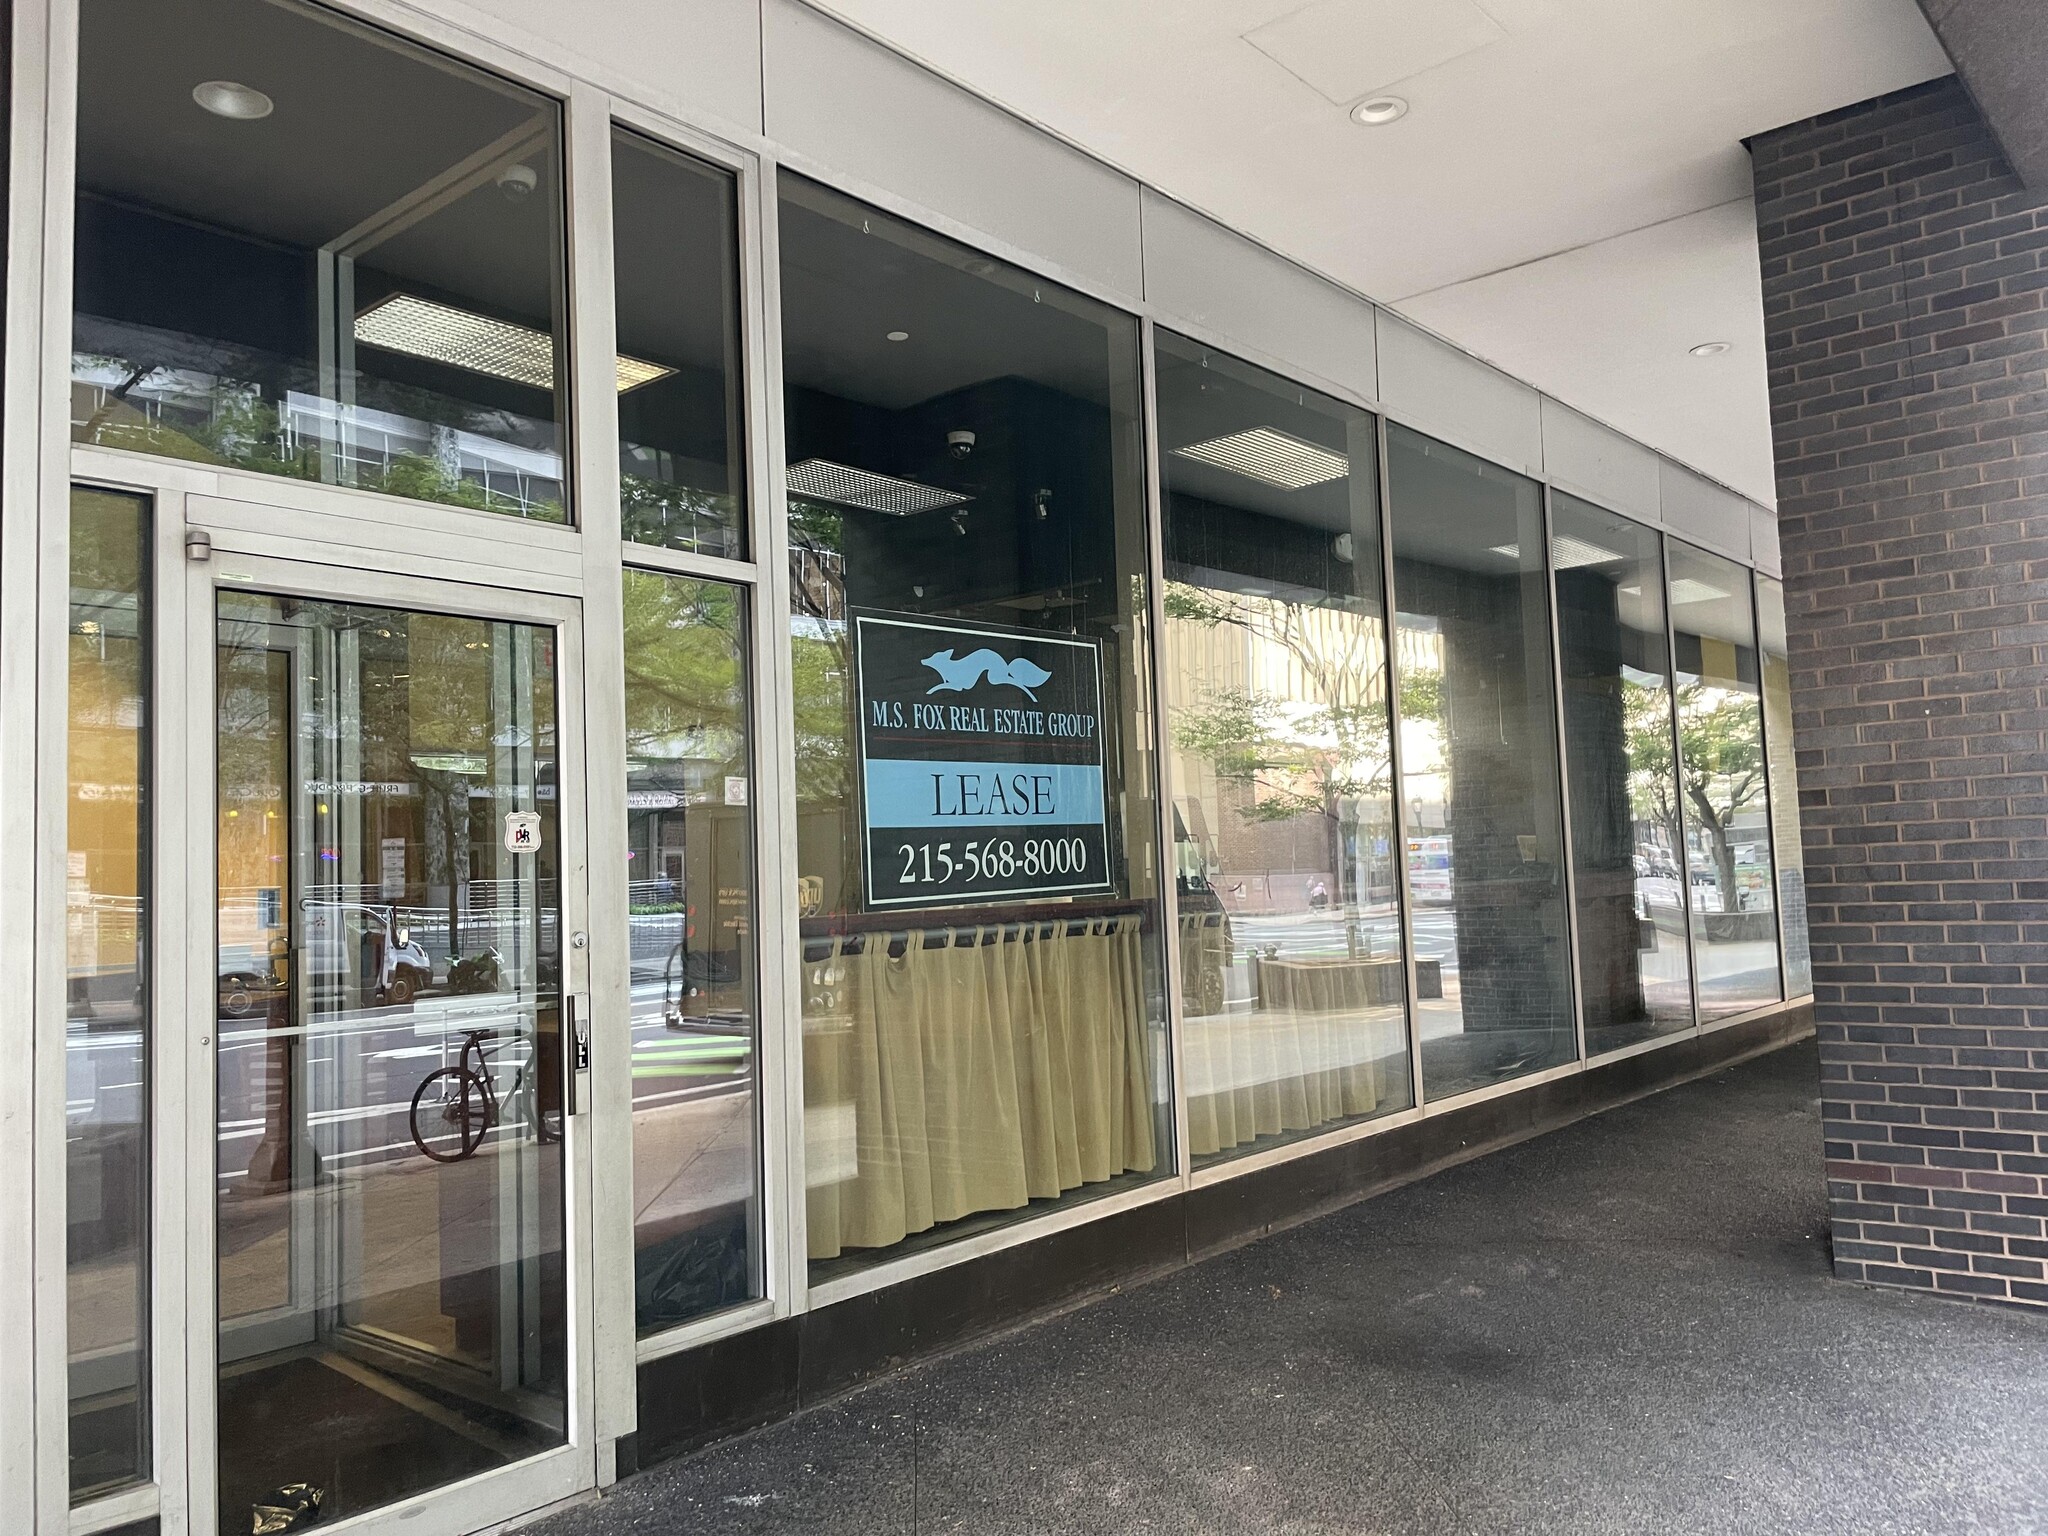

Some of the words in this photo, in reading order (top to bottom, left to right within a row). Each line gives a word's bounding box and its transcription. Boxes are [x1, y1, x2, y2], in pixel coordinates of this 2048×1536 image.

[872, 700, 908, 729] M.S.
[913, 703, 946, 732] FOX
[949, 706, 990, 733] REAL
[993, 709, 1044, 736] ESTATE
[1047, 712, 1096, 739] GROUP
[931, 773, 1056, 816] LEASE
[898, 837, 1087, 885] 215-568-8000
